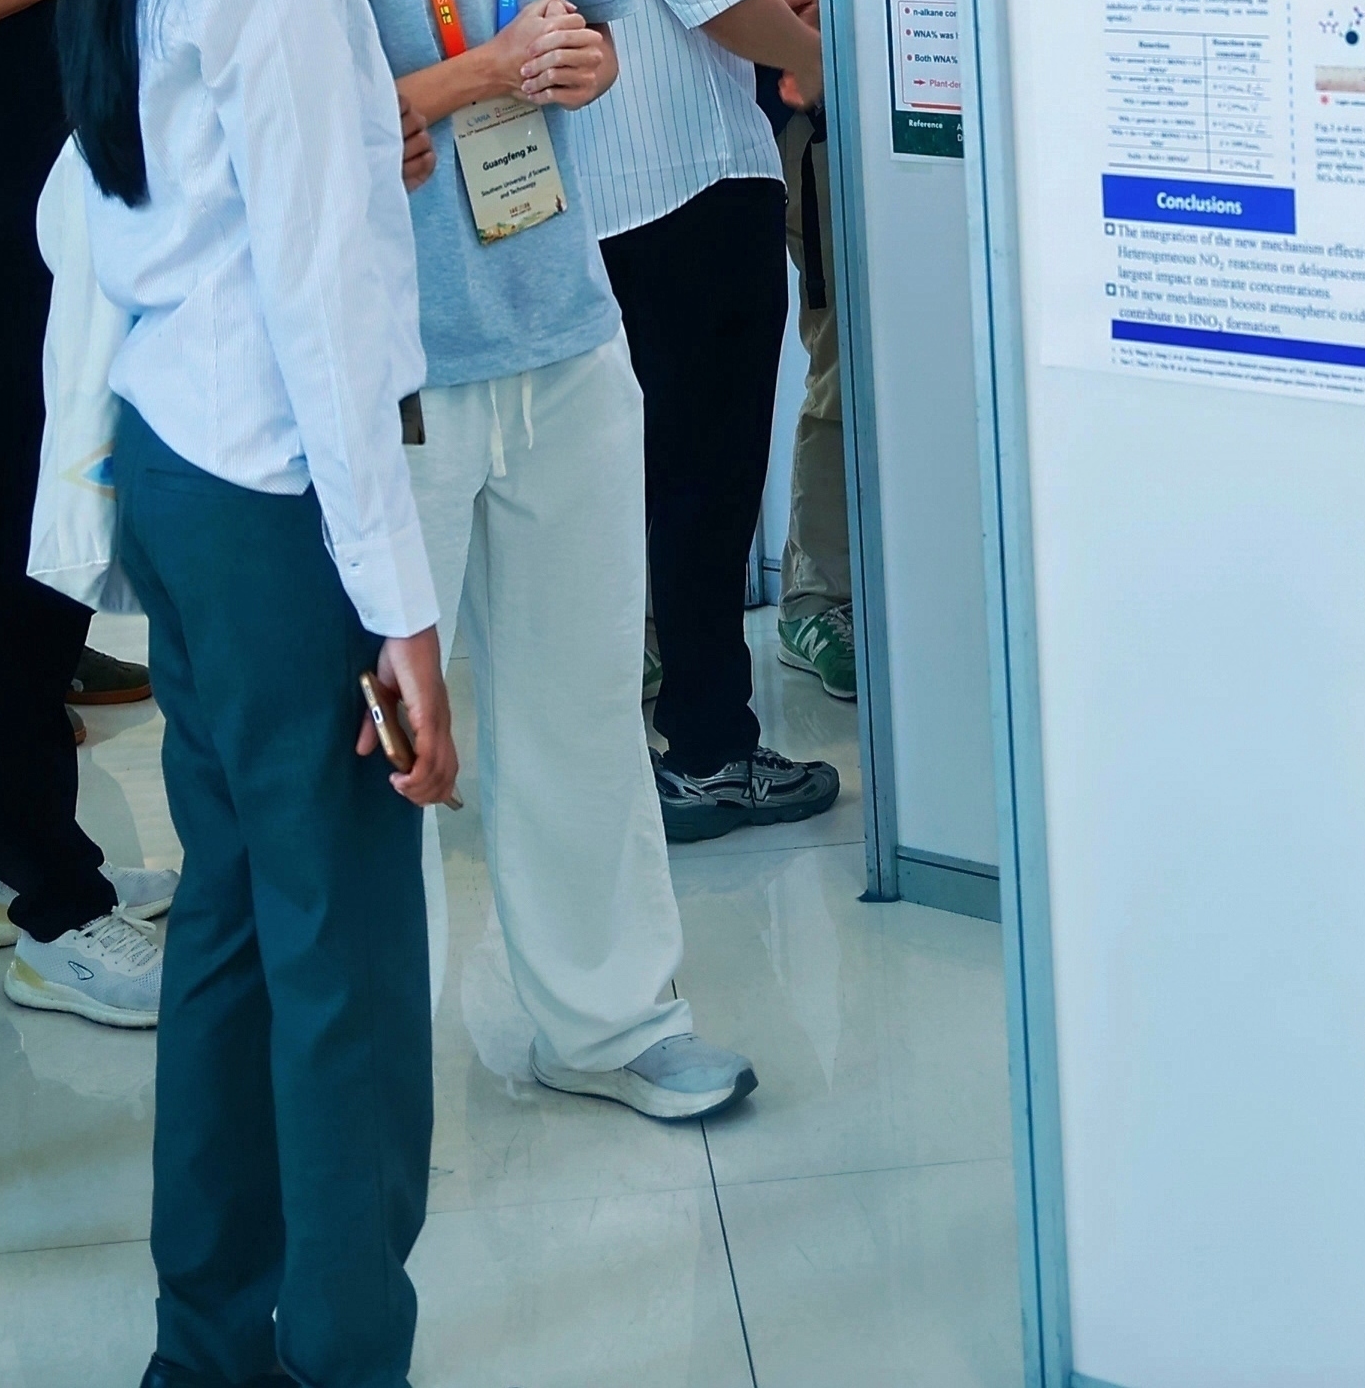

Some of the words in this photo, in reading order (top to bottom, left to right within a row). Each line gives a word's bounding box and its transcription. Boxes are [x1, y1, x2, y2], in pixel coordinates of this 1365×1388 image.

[913, 8, 943, 17] n-alkane
[914, 30, 938, 39] WNA%
[915, 54, 931, 62] Both
[933, 55, 958, 64] WNA%
[908, 119, 943, 129] Reference
[483, 148, 525, 171] Guangfeng
[527, 144, 538, 153] Xu
[481, 184, 502, 197] Southern
[504, 175, 527, 188] University
[533, 165, 550, 177] Science
[500, 191, 509, 199] and
[509, 182, 536, 197] Technology
[1156, 192, 1243, 215] Conclusions
[1118, 225, 1138, 237] The
[1141, 227, 1198, 243] integration
[1200, 232, 1213, 244] of
[1215, 232, 1231, 246] the
[1235, 239, 1257, 248] new
[1261, 239, 1324, 254] mechanism
[1119, 285, 1139, 298] The
[1142, 291, 1163, 301] new
[1166, 292, 1228, 308] mechanism
[1230, 297, 1266, 311] boosts
[1270, 303, 1336, 320] atmospheric
